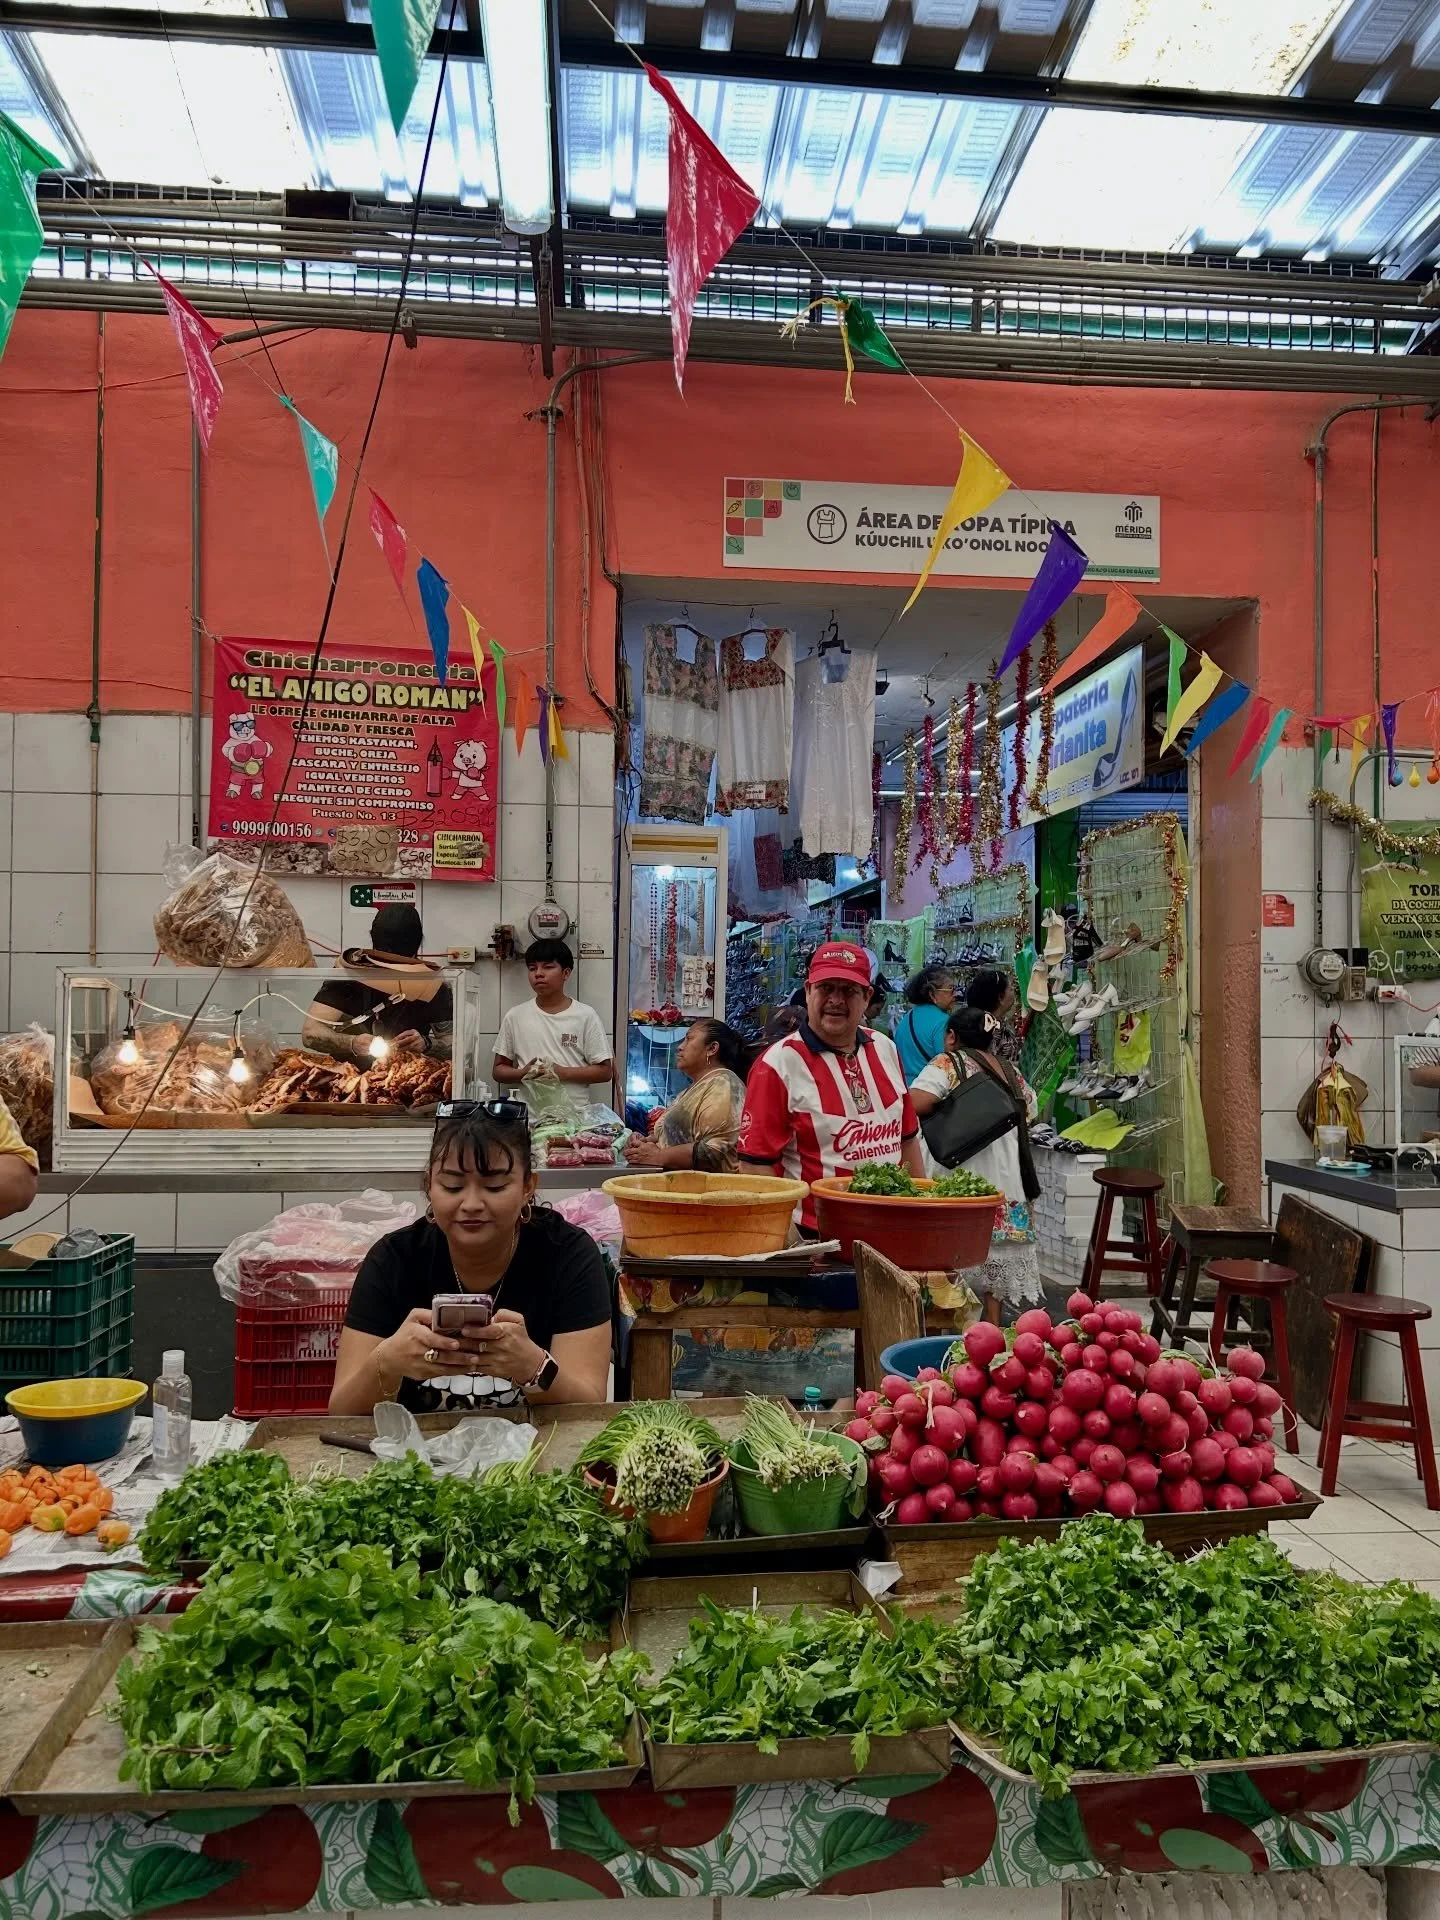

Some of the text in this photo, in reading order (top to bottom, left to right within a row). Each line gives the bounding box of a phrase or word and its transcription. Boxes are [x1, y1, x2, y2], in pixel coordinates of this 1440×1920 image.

[856, 506, 913, 529] ÁREA
[917, 511, 943, 530] DE
[953, 517, 1004, 533] OPA
[855, 530, 924, 549] KÚUCHIL
[1015, 540, 1049, 553] NOO
[244, 649, 477, 681] Chicharroneia
[281, 678, 368, 705] AMIGO
[251, 704, 456, 727] LE OFRECE CHICHARRA DE ALTA
[292, 720, 415, 737] CALIDAD Y FRESCA
[348, 737, 418, 750] KASTAKAN,
[315, 747, 397, 760] BUCHE, OREJA
[292, 758, 421, 773] CASCARA Y ENTRESIJO
[305, 771, 405, 784] IGUAL VENDEMOS
[297, 783, 412, 797] MANTECA DE CERDO
[273, 793, 434, 811] PREGUNTE SIN COMPROMISO
[312, 808, 396, 821] Puesto No. 13
[337, 828, 391, 848] $320
[436, 833, 481, 843] CHICHARRÓN
[545, 819, 554, 854] LOC
